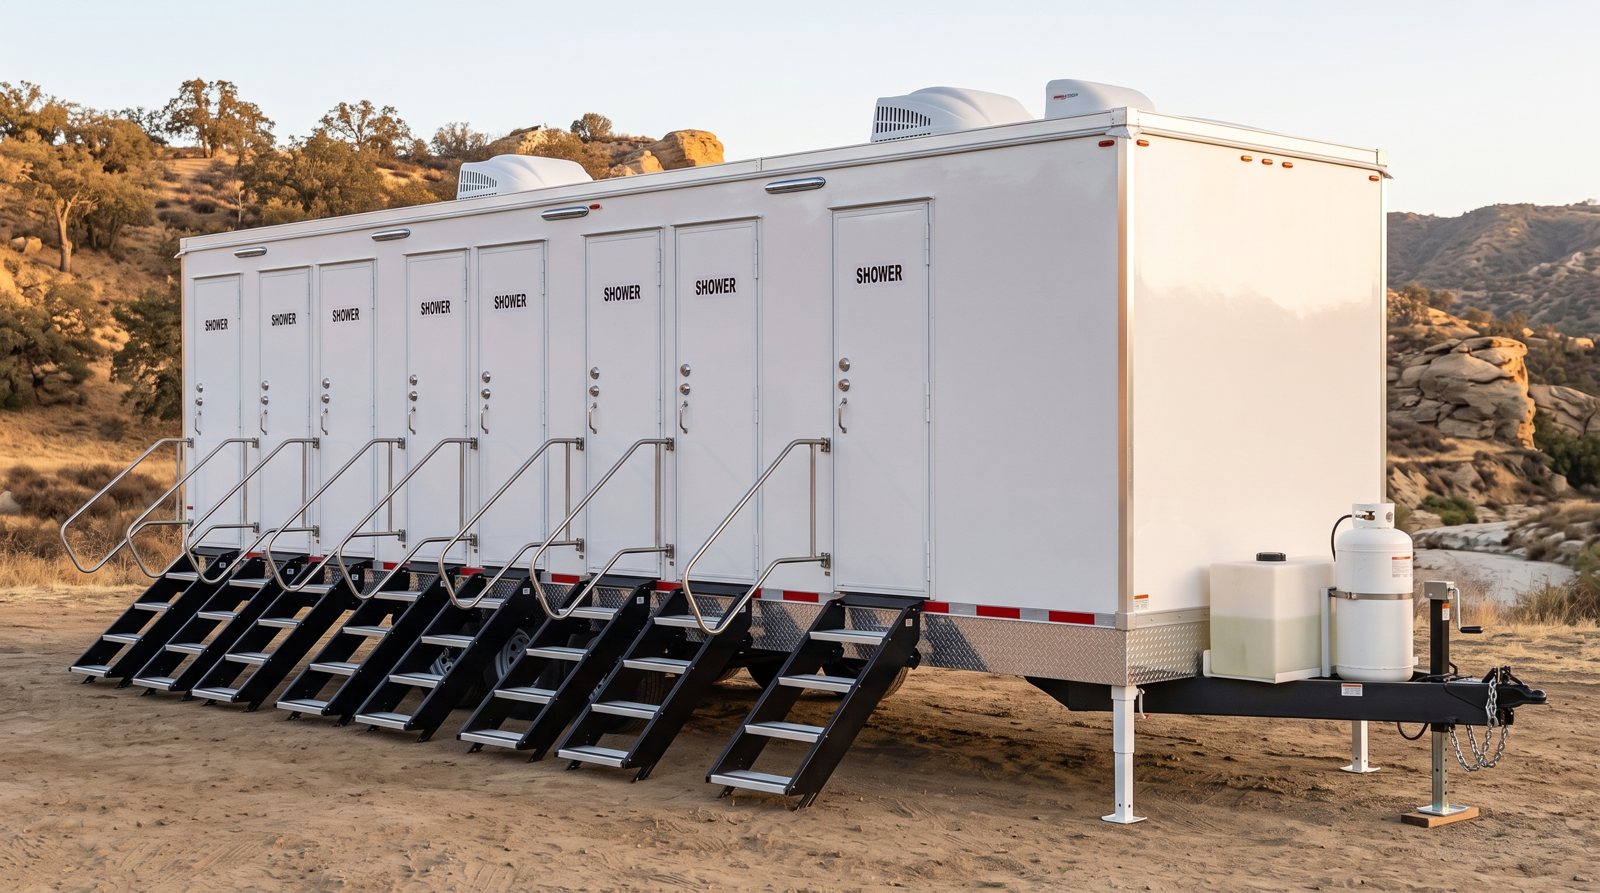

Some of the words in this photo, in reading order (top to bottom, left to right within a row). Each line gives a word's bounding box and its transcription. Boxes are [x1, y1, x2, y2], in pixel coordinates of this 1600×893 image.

[857, 265, 902, 284] SHOWER
[604, 285, 640, 302] SHOWER
[695, 278, 736, 296] SHOWER
[420, 300, 450, 315] SHOWER
[494, 294, 526, 310] SHOWER
[271, 313, 296, 327] SHOWER
[332, 308, 359, 323] SHOWER
[205, 318, 228, 331] SHOWER
